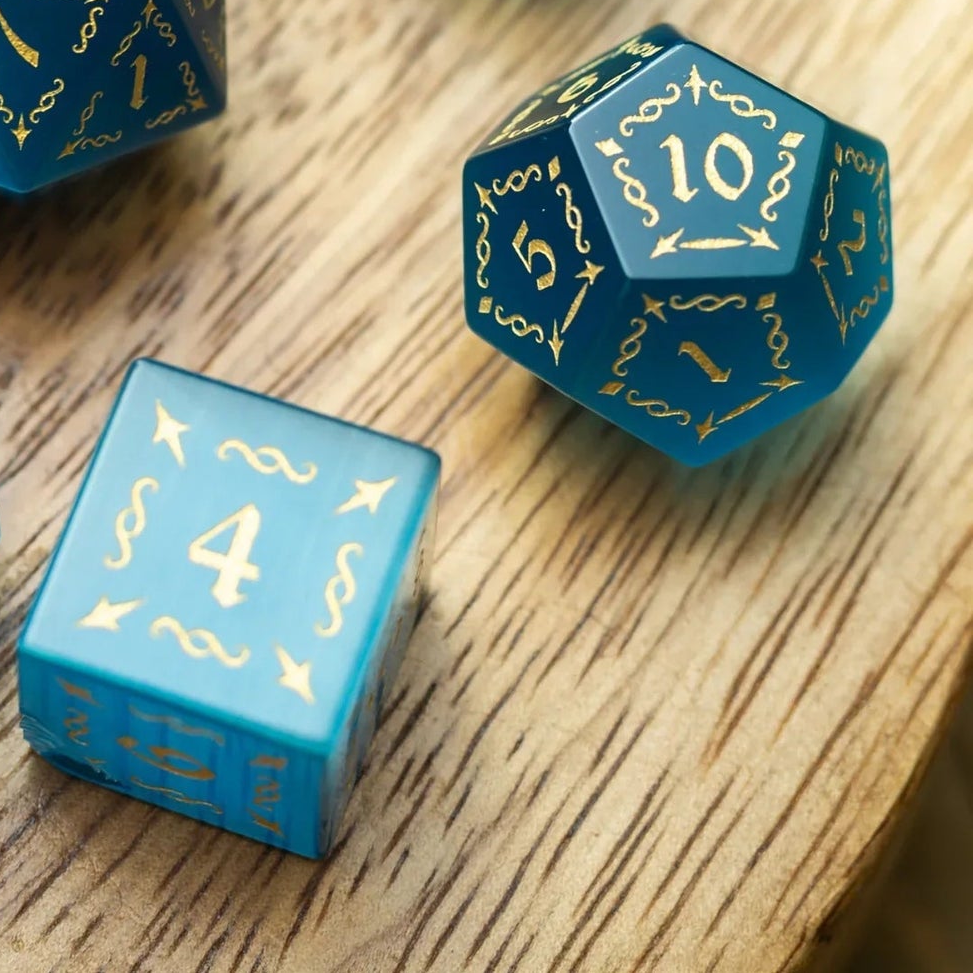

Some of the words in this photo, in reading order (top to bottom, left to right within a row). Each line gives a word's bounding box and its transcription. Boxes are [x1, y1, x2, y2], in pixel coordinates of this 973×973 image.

[129, 54, 147, 110] 1
[660, 132, 753, 203] 10
[511, 220, 557, 291] 5
[677, 341, 731, 383] 1
[188, 502, 262, 608] 4
